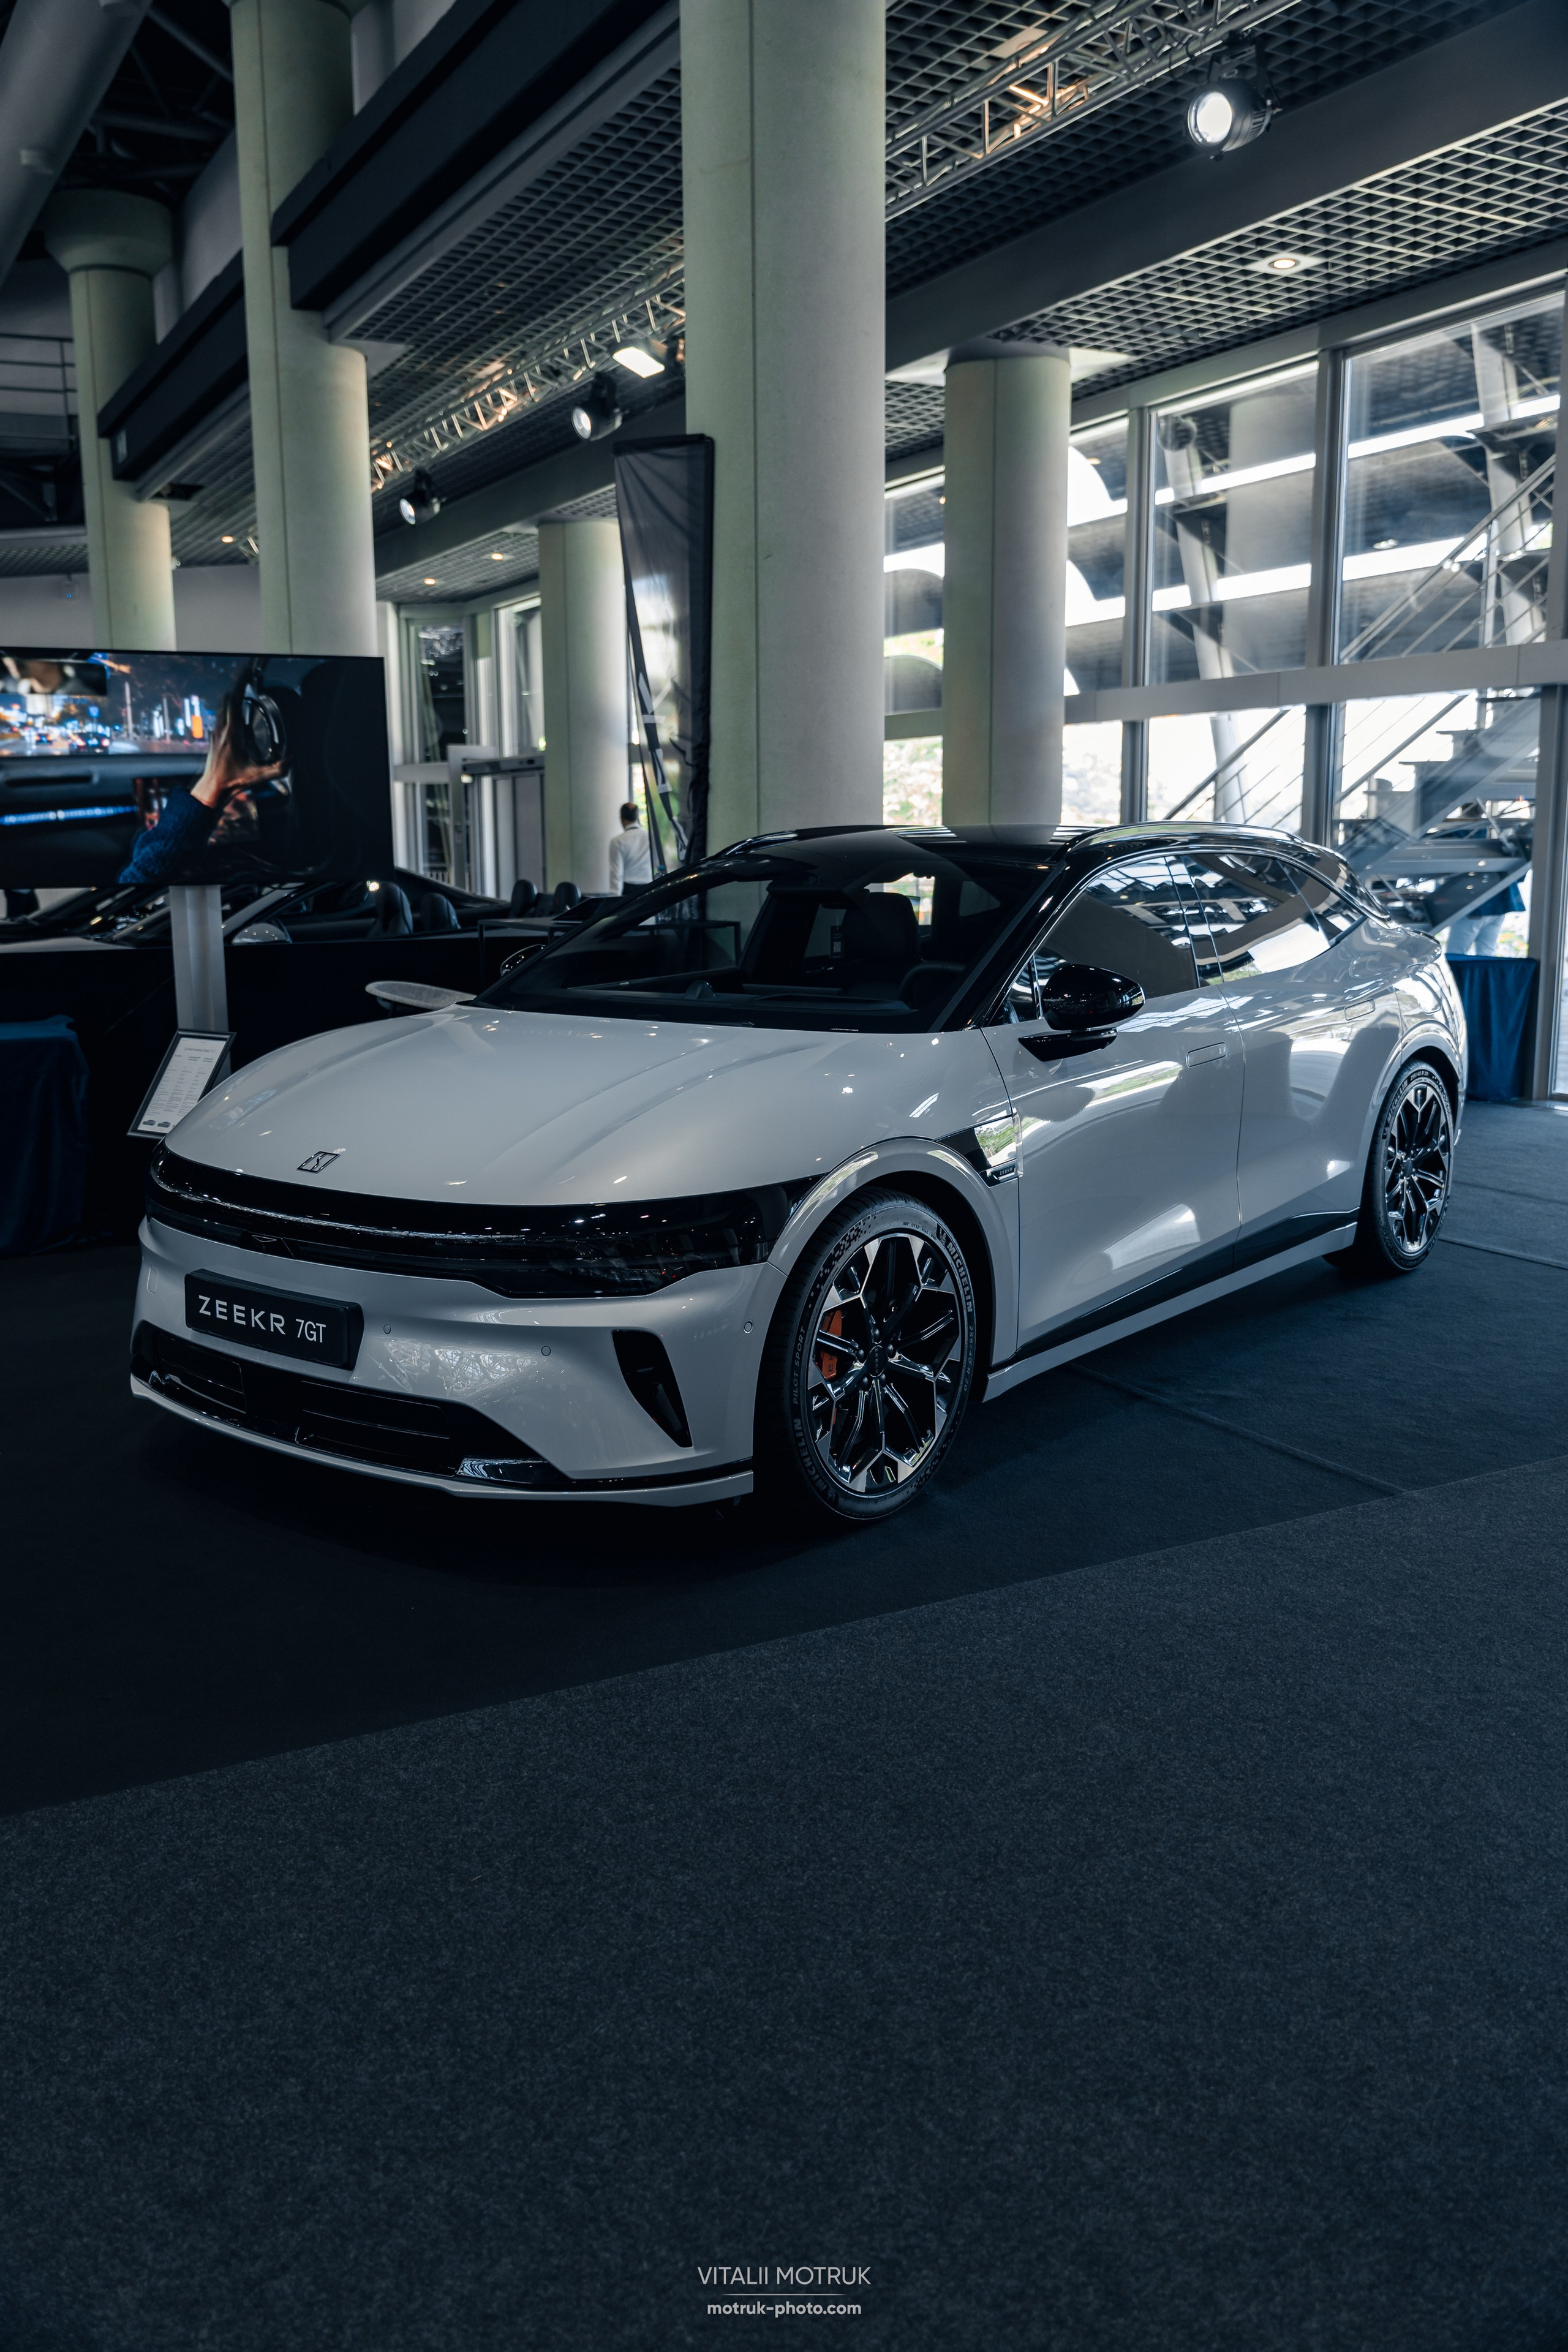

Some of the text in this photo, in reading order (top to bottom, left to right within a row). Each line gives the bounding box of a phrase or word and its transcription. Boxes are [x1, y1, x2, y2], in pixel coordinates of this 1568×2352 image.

[1387, 1079, 1408, 1123] MICHELIN
[946, 1242, 973, 1313] MICHELIN
[198, 1294, 326, 1343] ZEEKR 7GT
[794, 1325, 805, 1367] SPORT
[793, 1418, 827, 1492] MICHELIN
